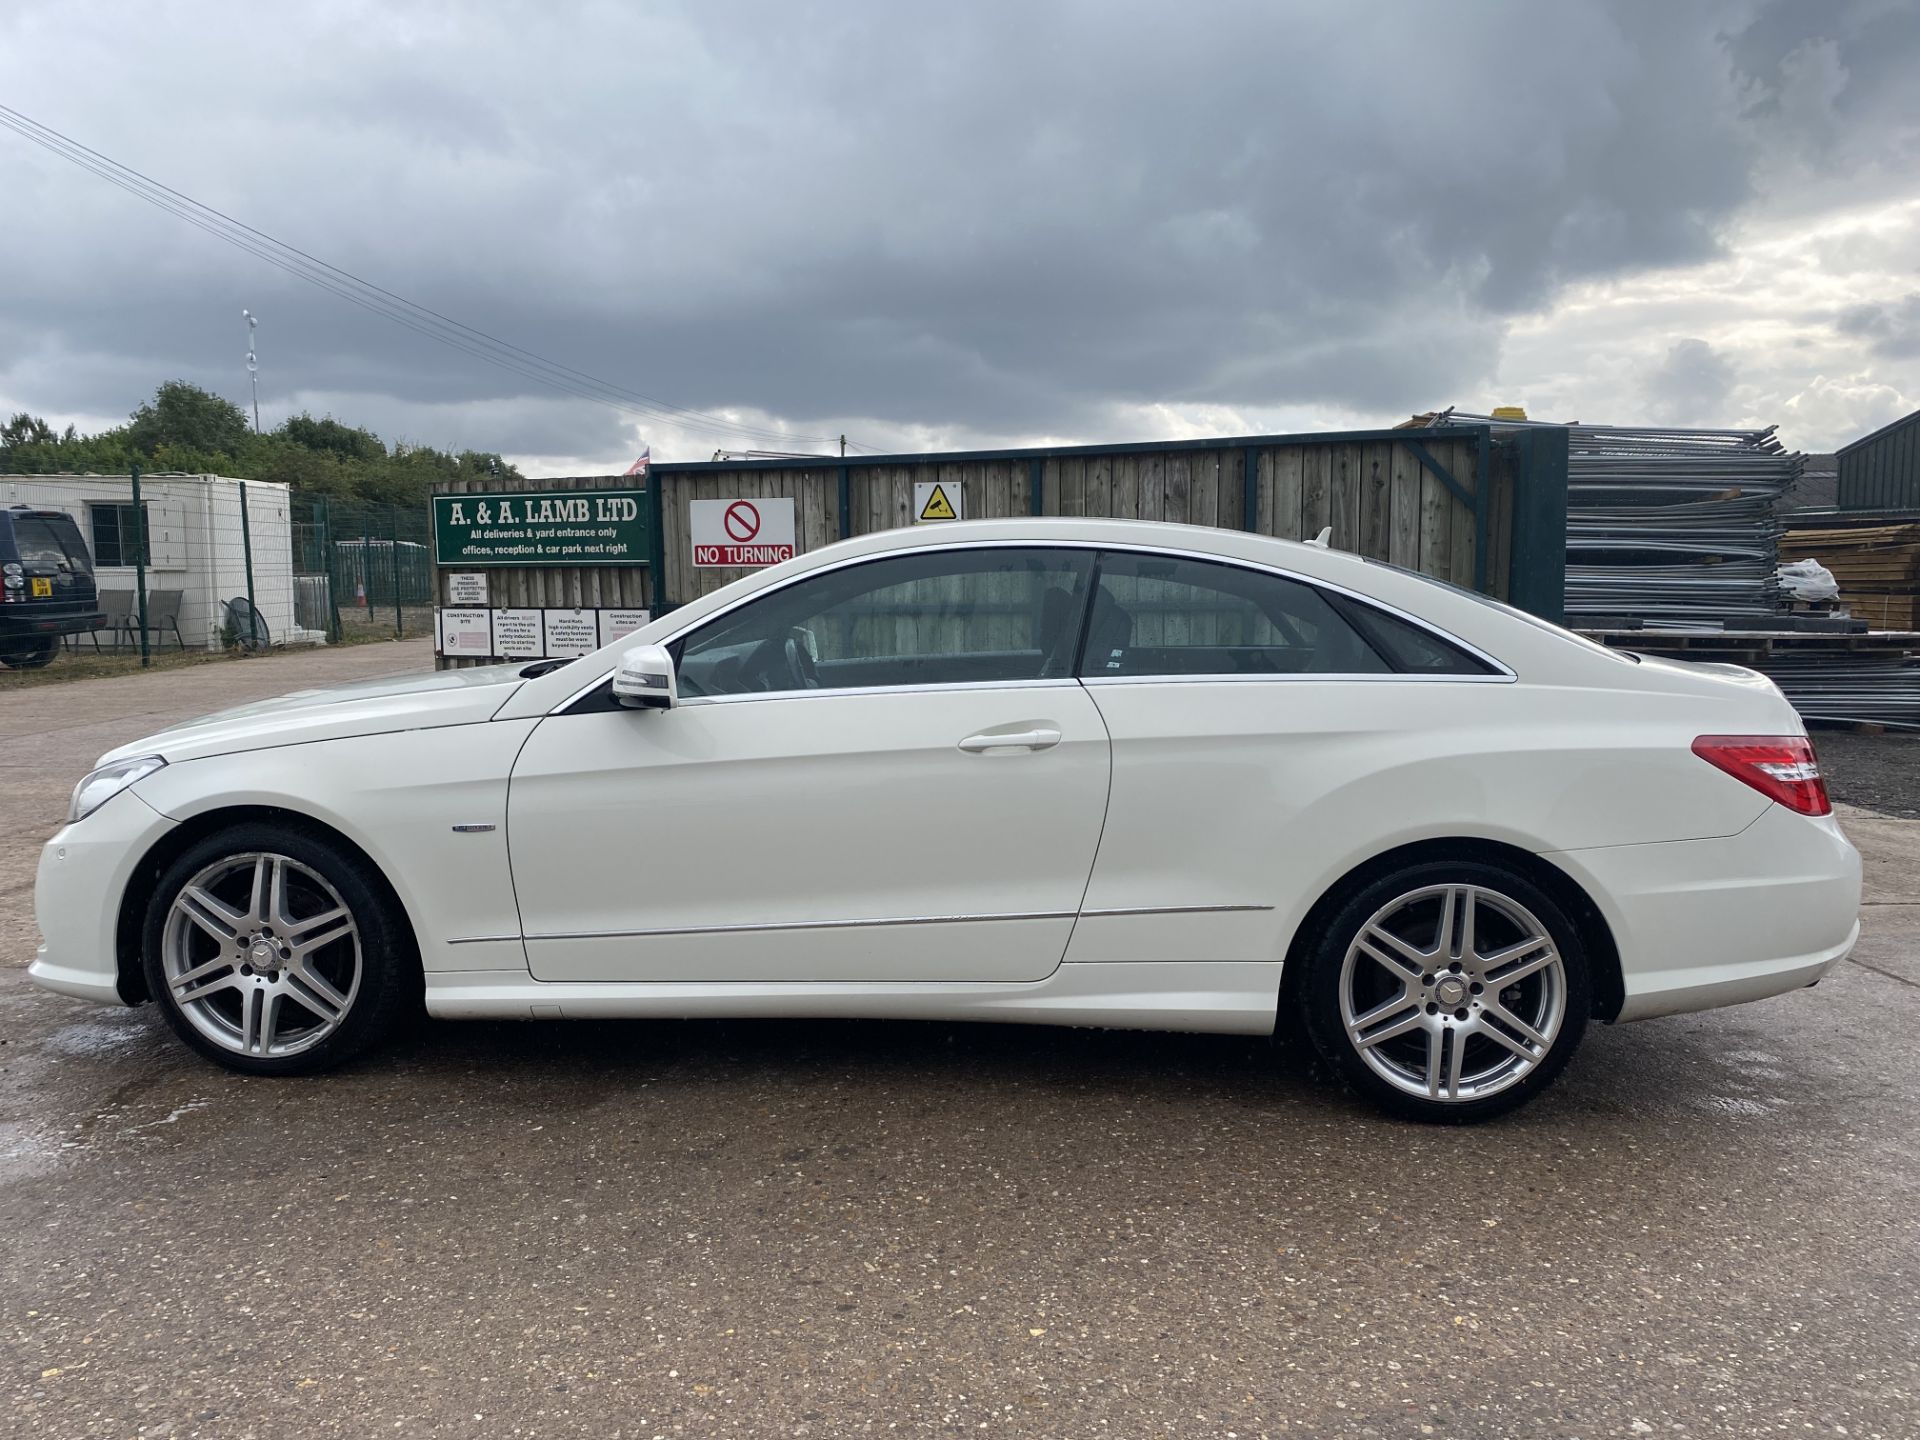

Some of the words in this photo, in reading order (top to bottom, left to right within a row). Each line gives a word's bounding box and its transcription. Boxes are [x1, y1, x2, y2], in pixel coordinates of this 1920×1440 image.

[449, 503, 471, 525] A.
[477, 501, 492, 525] &
[498, 501, 520, 524] A.
[525, 499, 590, 523] LAMB
[596, 498, 638, 522] LTD
[470, 530, 482, 539] All
[484, 529, 524, 539] deliveries
[526, 528, 533, 538] &
[535, 528, 555, 540] yard
[557, 528, 596, 537] entrance
[598, 527, 617, 538] only
[462, 545, 493, 556] offices,
[495, 544, 534, 555] reception
[536, 544, 543, 553] &
[562, 544, 582, 555] park
[585, 544, 604, 553] next
[606, 543, 628, 555] right
[698, 547, 720, 563] NO
[725, 546, 790, 563] TURNING
